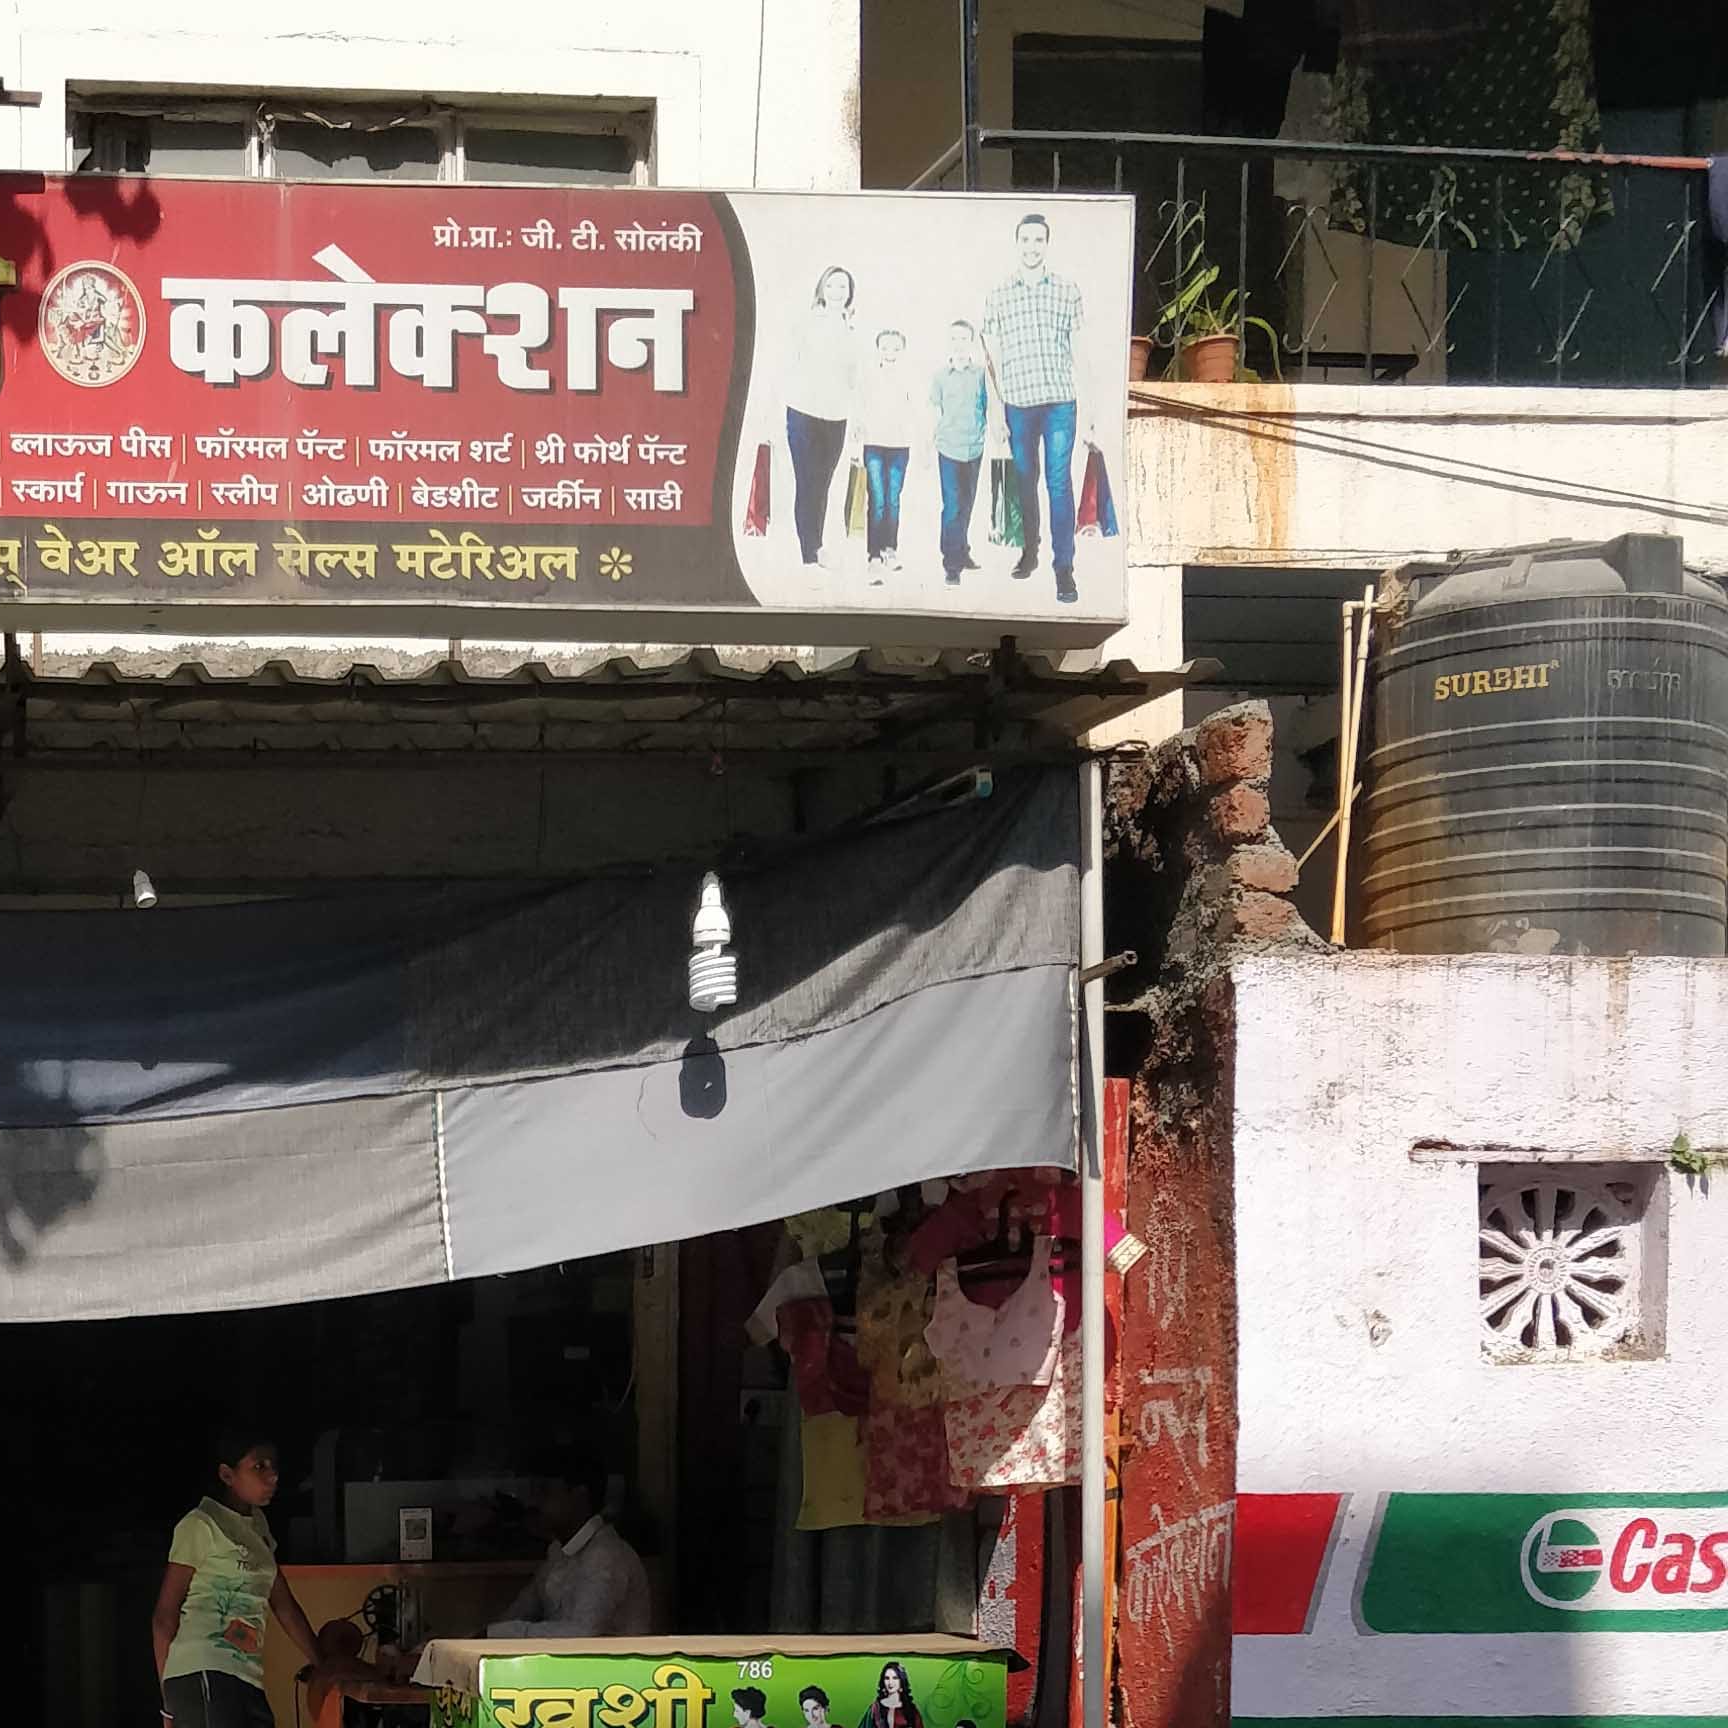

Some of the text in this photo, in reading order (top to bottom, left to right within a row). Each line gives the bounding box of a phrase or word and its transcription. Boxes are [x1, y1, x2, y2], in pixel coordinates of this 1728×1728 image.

[521, 219, 562, 250] जी.
[571, 220, 605, 251] टी.
[614, 221, 704, 252] सोलंकी
[161, 242, 696, 392] कलेक्शन
[10, 433, 112, 458] ब्लाऊज
[120, 426, 172, 458] पीस
[195, 427, 288, 459] फॉरमल
[296, 428, 346, 460] पॅन्ट
[368, 430, 461, 462] फॉरमल
[469, 432, 514, 464] शर्ट
[573, 434, 632, 464] फोर्थ
[637, 435, 687, 465] पॅन्ट
[12, 472, 86, 504] स्कार्प
[106, 481, 188, 505] गाऊन
[211, 474, 279, 505] स्लीप
[302, 475, 389, 507] ओढणी
[411, 477, 499, 509] बेडशीट
[521, 479, 602, 510] जर्कीन
[624, 480, 682, 511] साडी
[35, 524, 139, 577] वेअर
[157, 527, 260, 577] ऑल
[272, 527, 378, 580] सेल्स
[391, 529, 580, 582] मटेरिअल
[1434, 663, 1551, 701] SURBHI
[737, 1661, 772, 1680] 786
